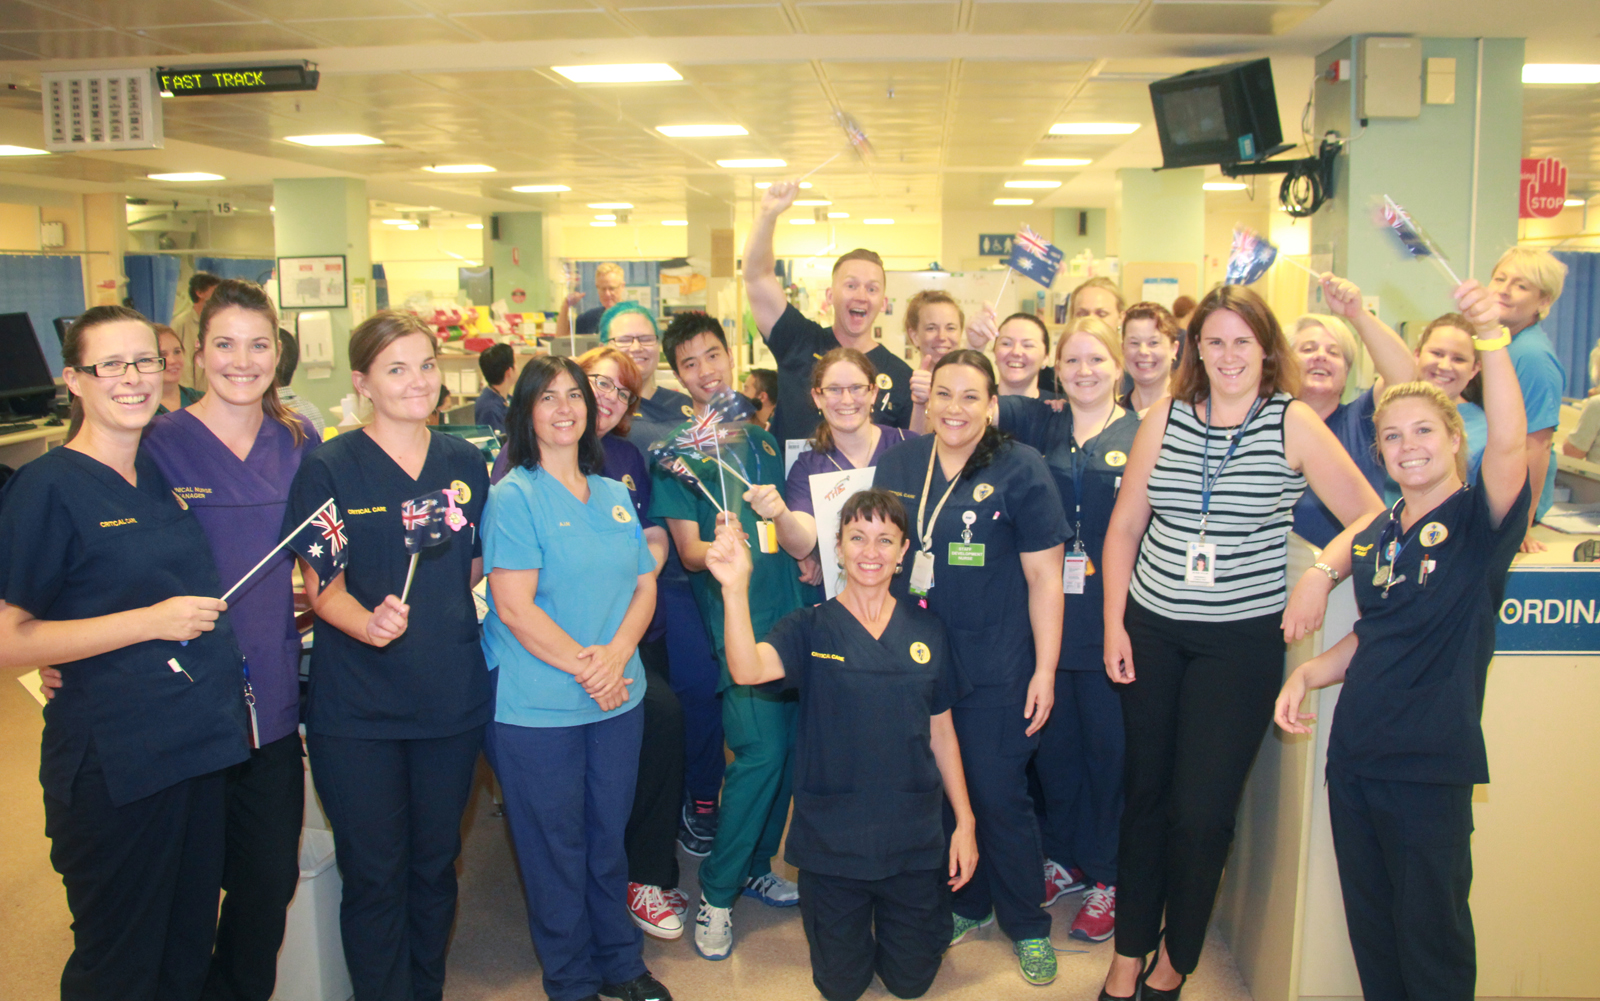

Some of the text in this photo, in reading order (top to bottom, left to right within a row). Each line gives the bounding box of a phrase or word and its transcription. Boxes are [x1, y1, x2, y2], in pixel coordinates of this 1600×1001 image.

[162, 71, 266, 90] FAST TRACK
[217, 202, 231, 213] 15
[1531, 197, 1564, 209] STOP
[824, 483, 846, 501] THE
[1498, 598, 1600, 625] ORDIN
